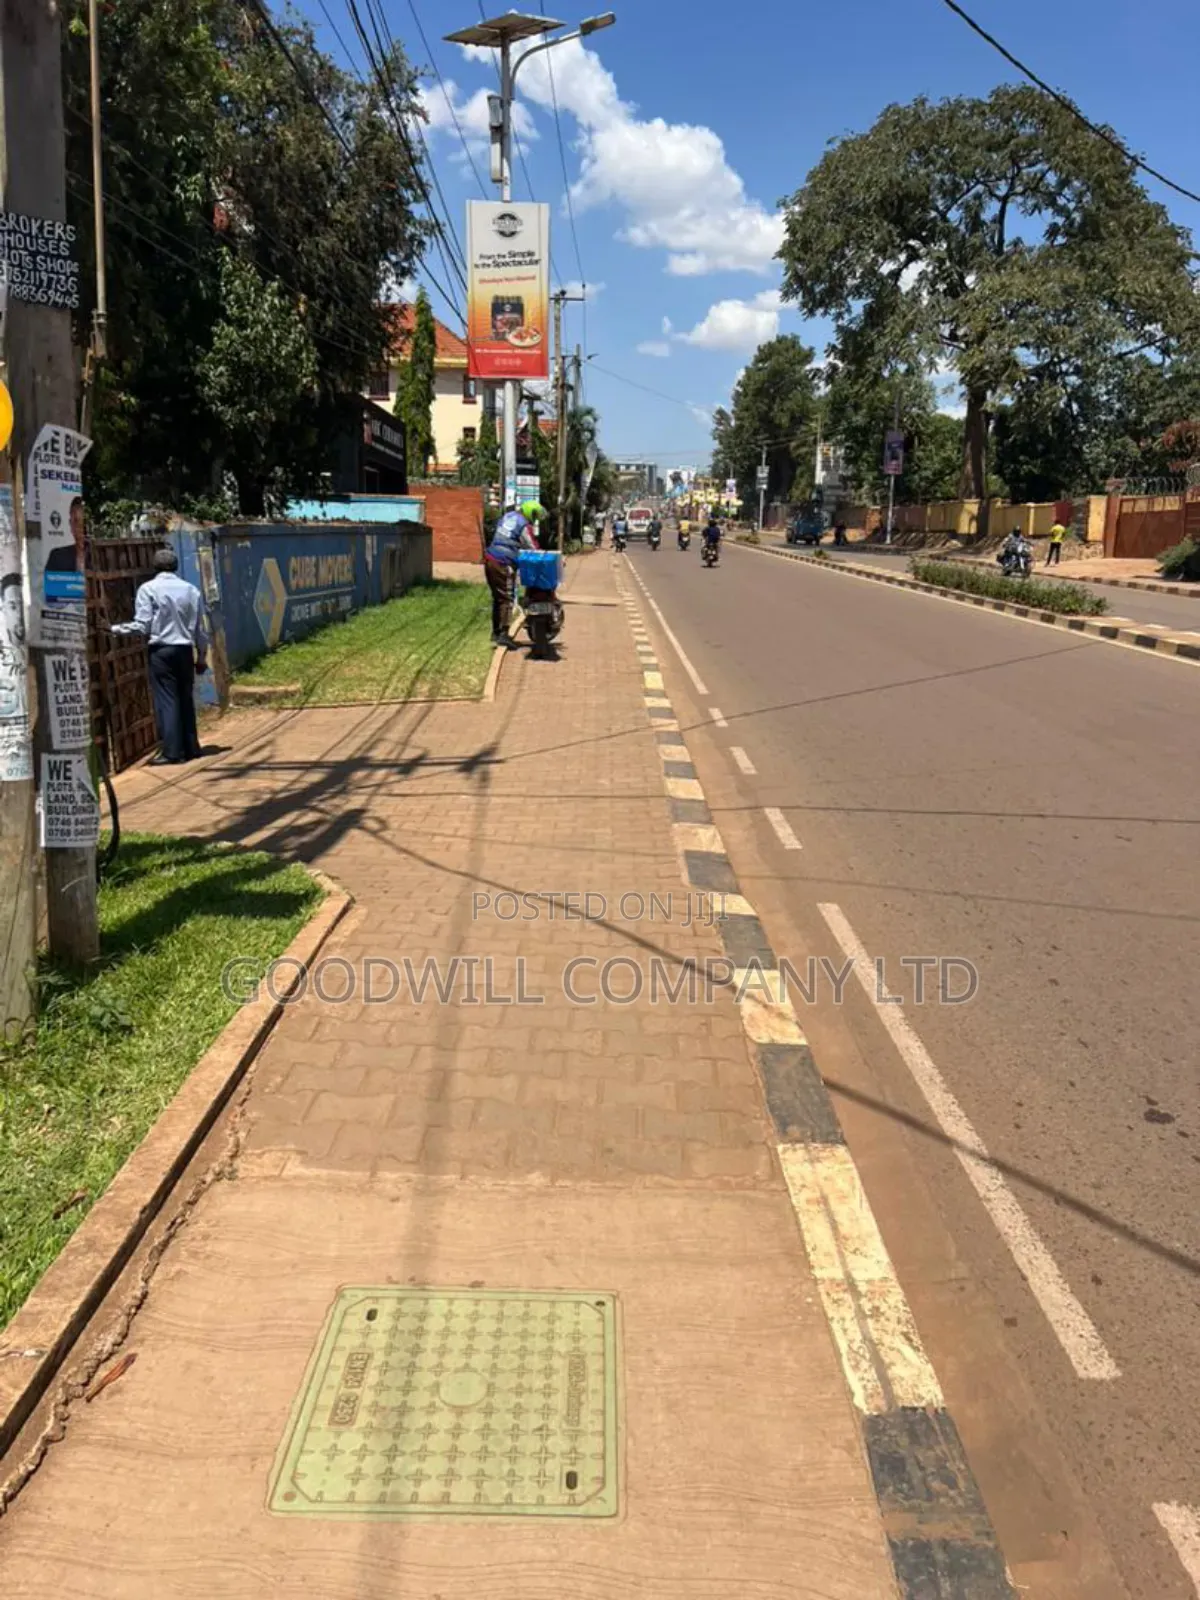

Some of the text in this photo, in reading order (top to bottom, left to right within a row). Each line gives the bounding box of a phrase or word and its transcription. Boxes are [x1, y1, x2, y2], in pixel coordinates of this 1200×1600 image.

[507, 250, 536, 260] Simple
[492, 258, 541, 269] Spectacular
[52, 660, 77, 681] WE
[47, 760, 72, 780] WE
